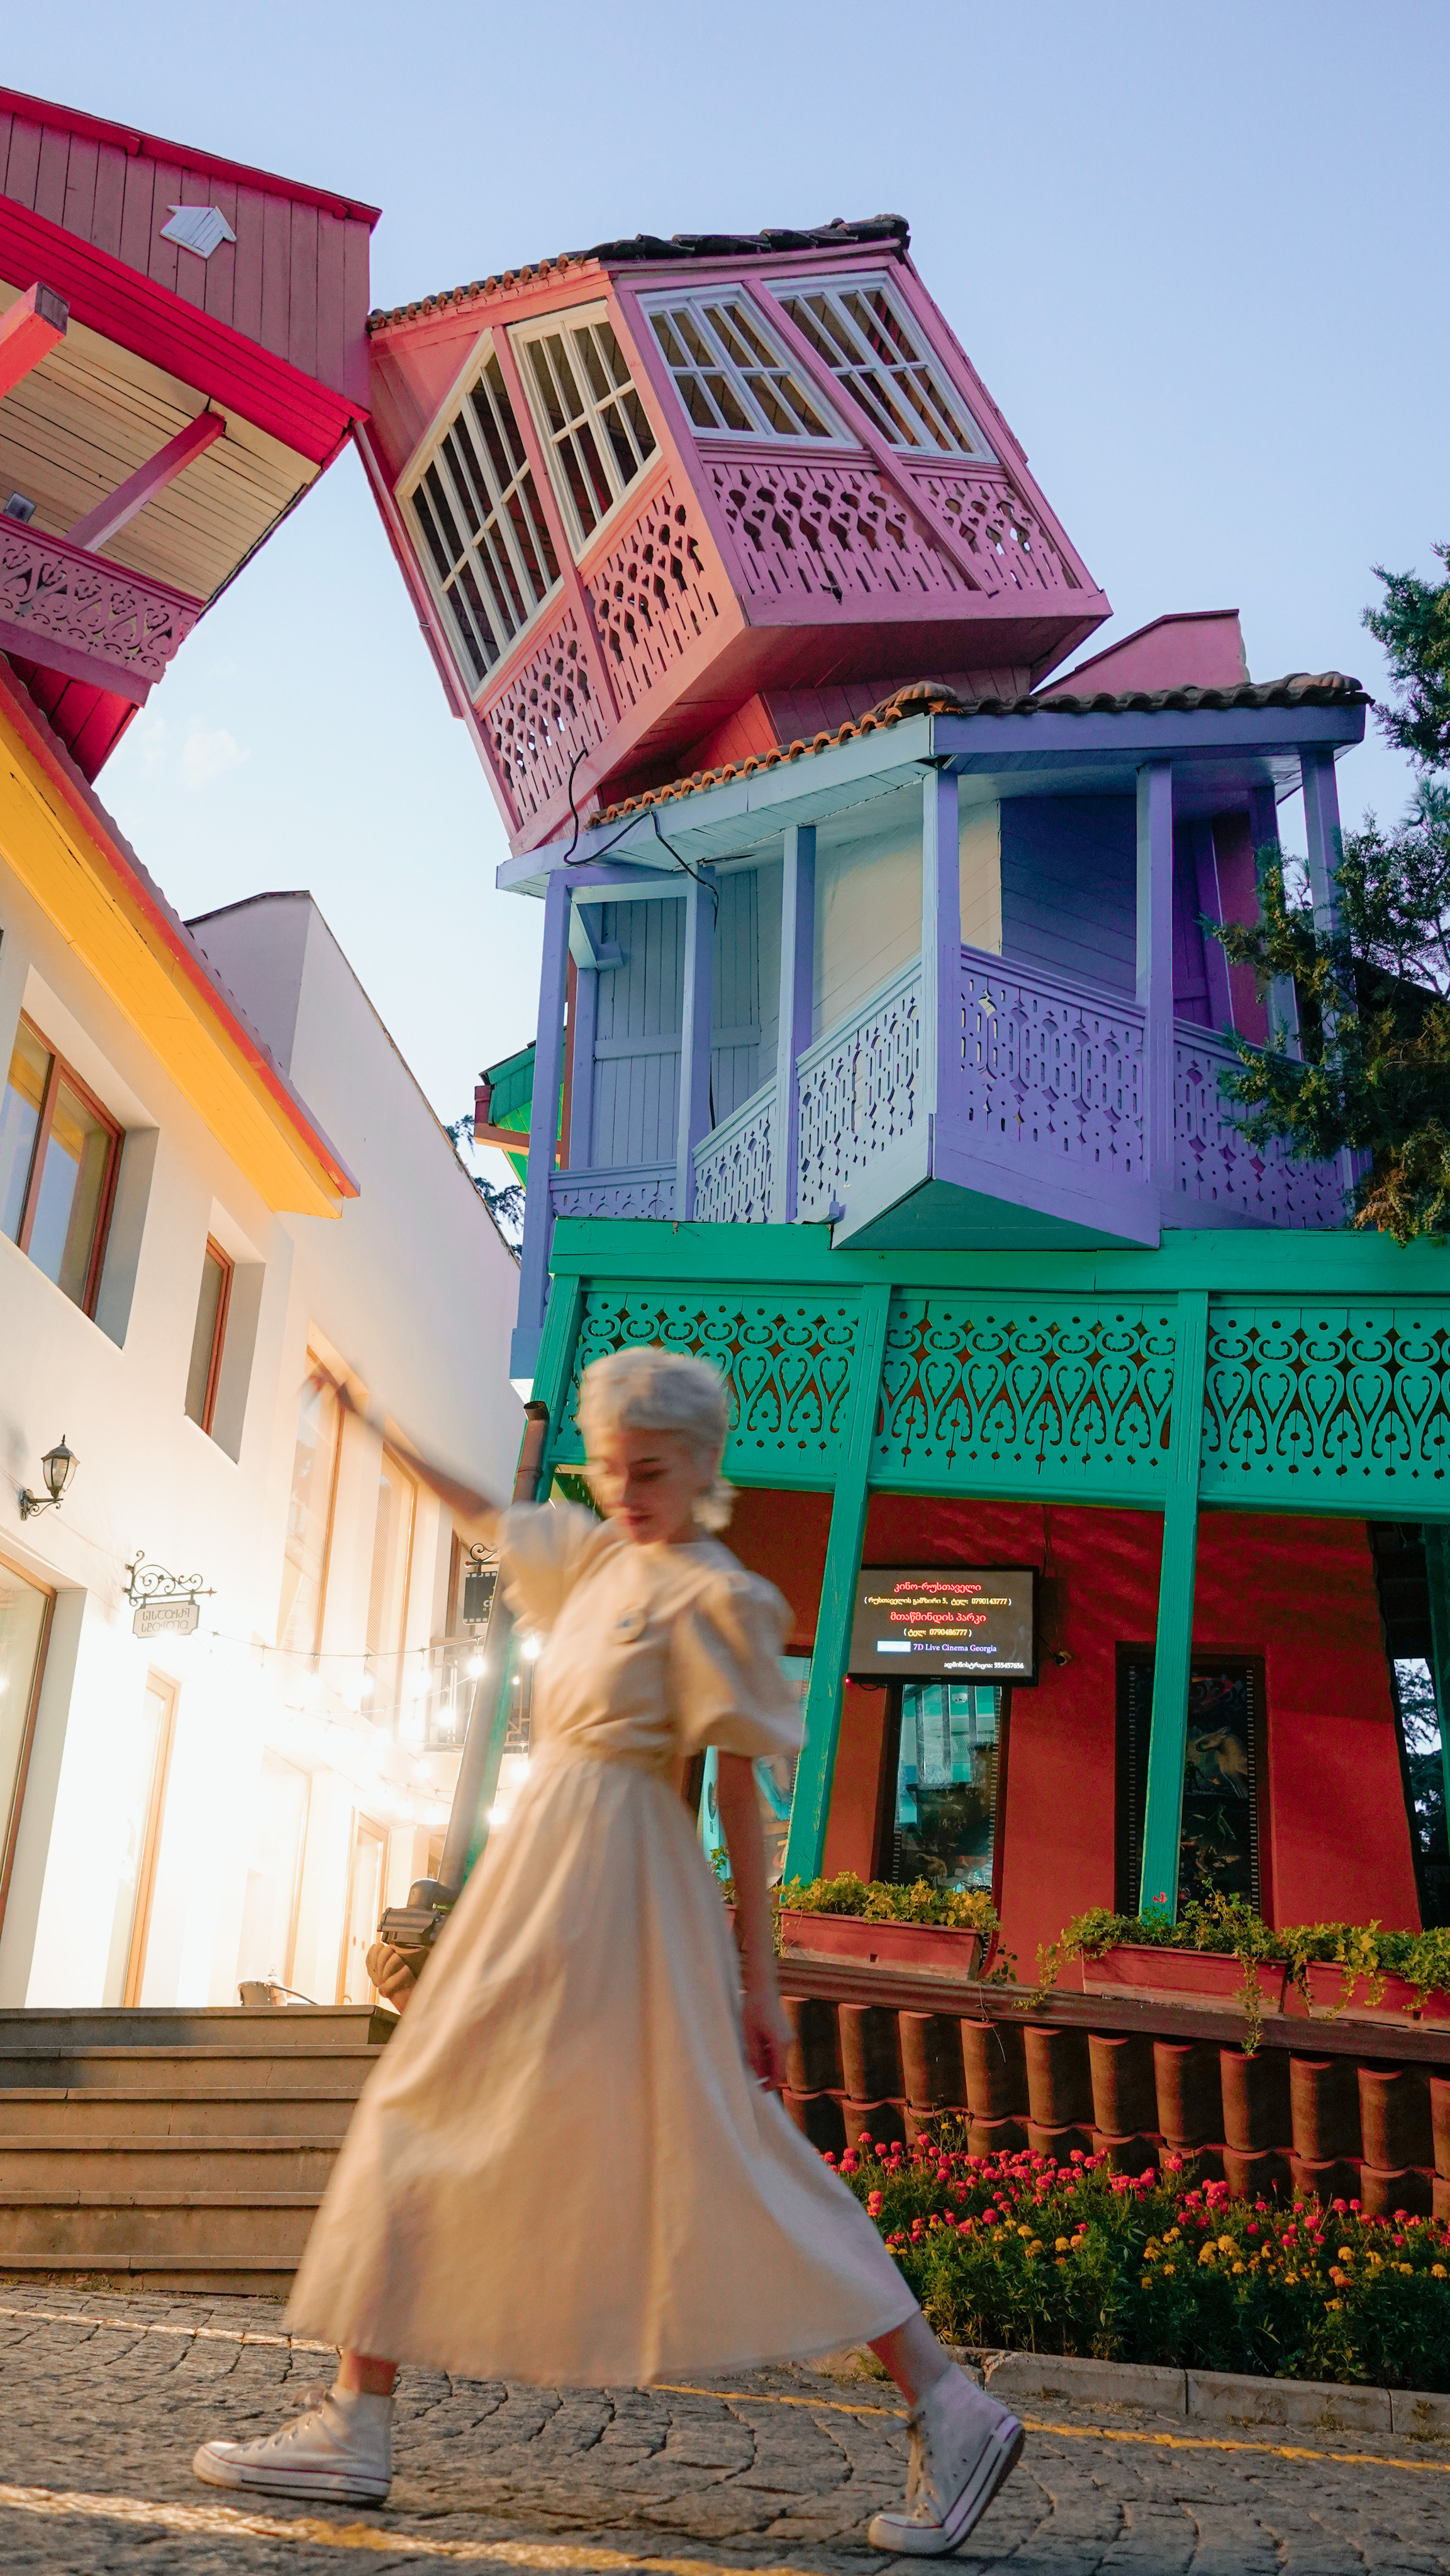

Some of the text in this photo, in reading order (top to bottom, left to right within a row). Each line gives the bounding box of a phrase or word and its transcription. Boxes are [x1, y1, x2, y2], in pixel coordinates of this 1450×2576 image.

[894, 1581, 982, 1594] კინო-რუსთაველი
[913, 1597, 941, 1606] გამზირი
[890, 1611, 987, 1624] მთაწმინდის პარკი
[913, 1643, 923, 1651] 7D
[970, 1645, 997, 1653] Georgia
